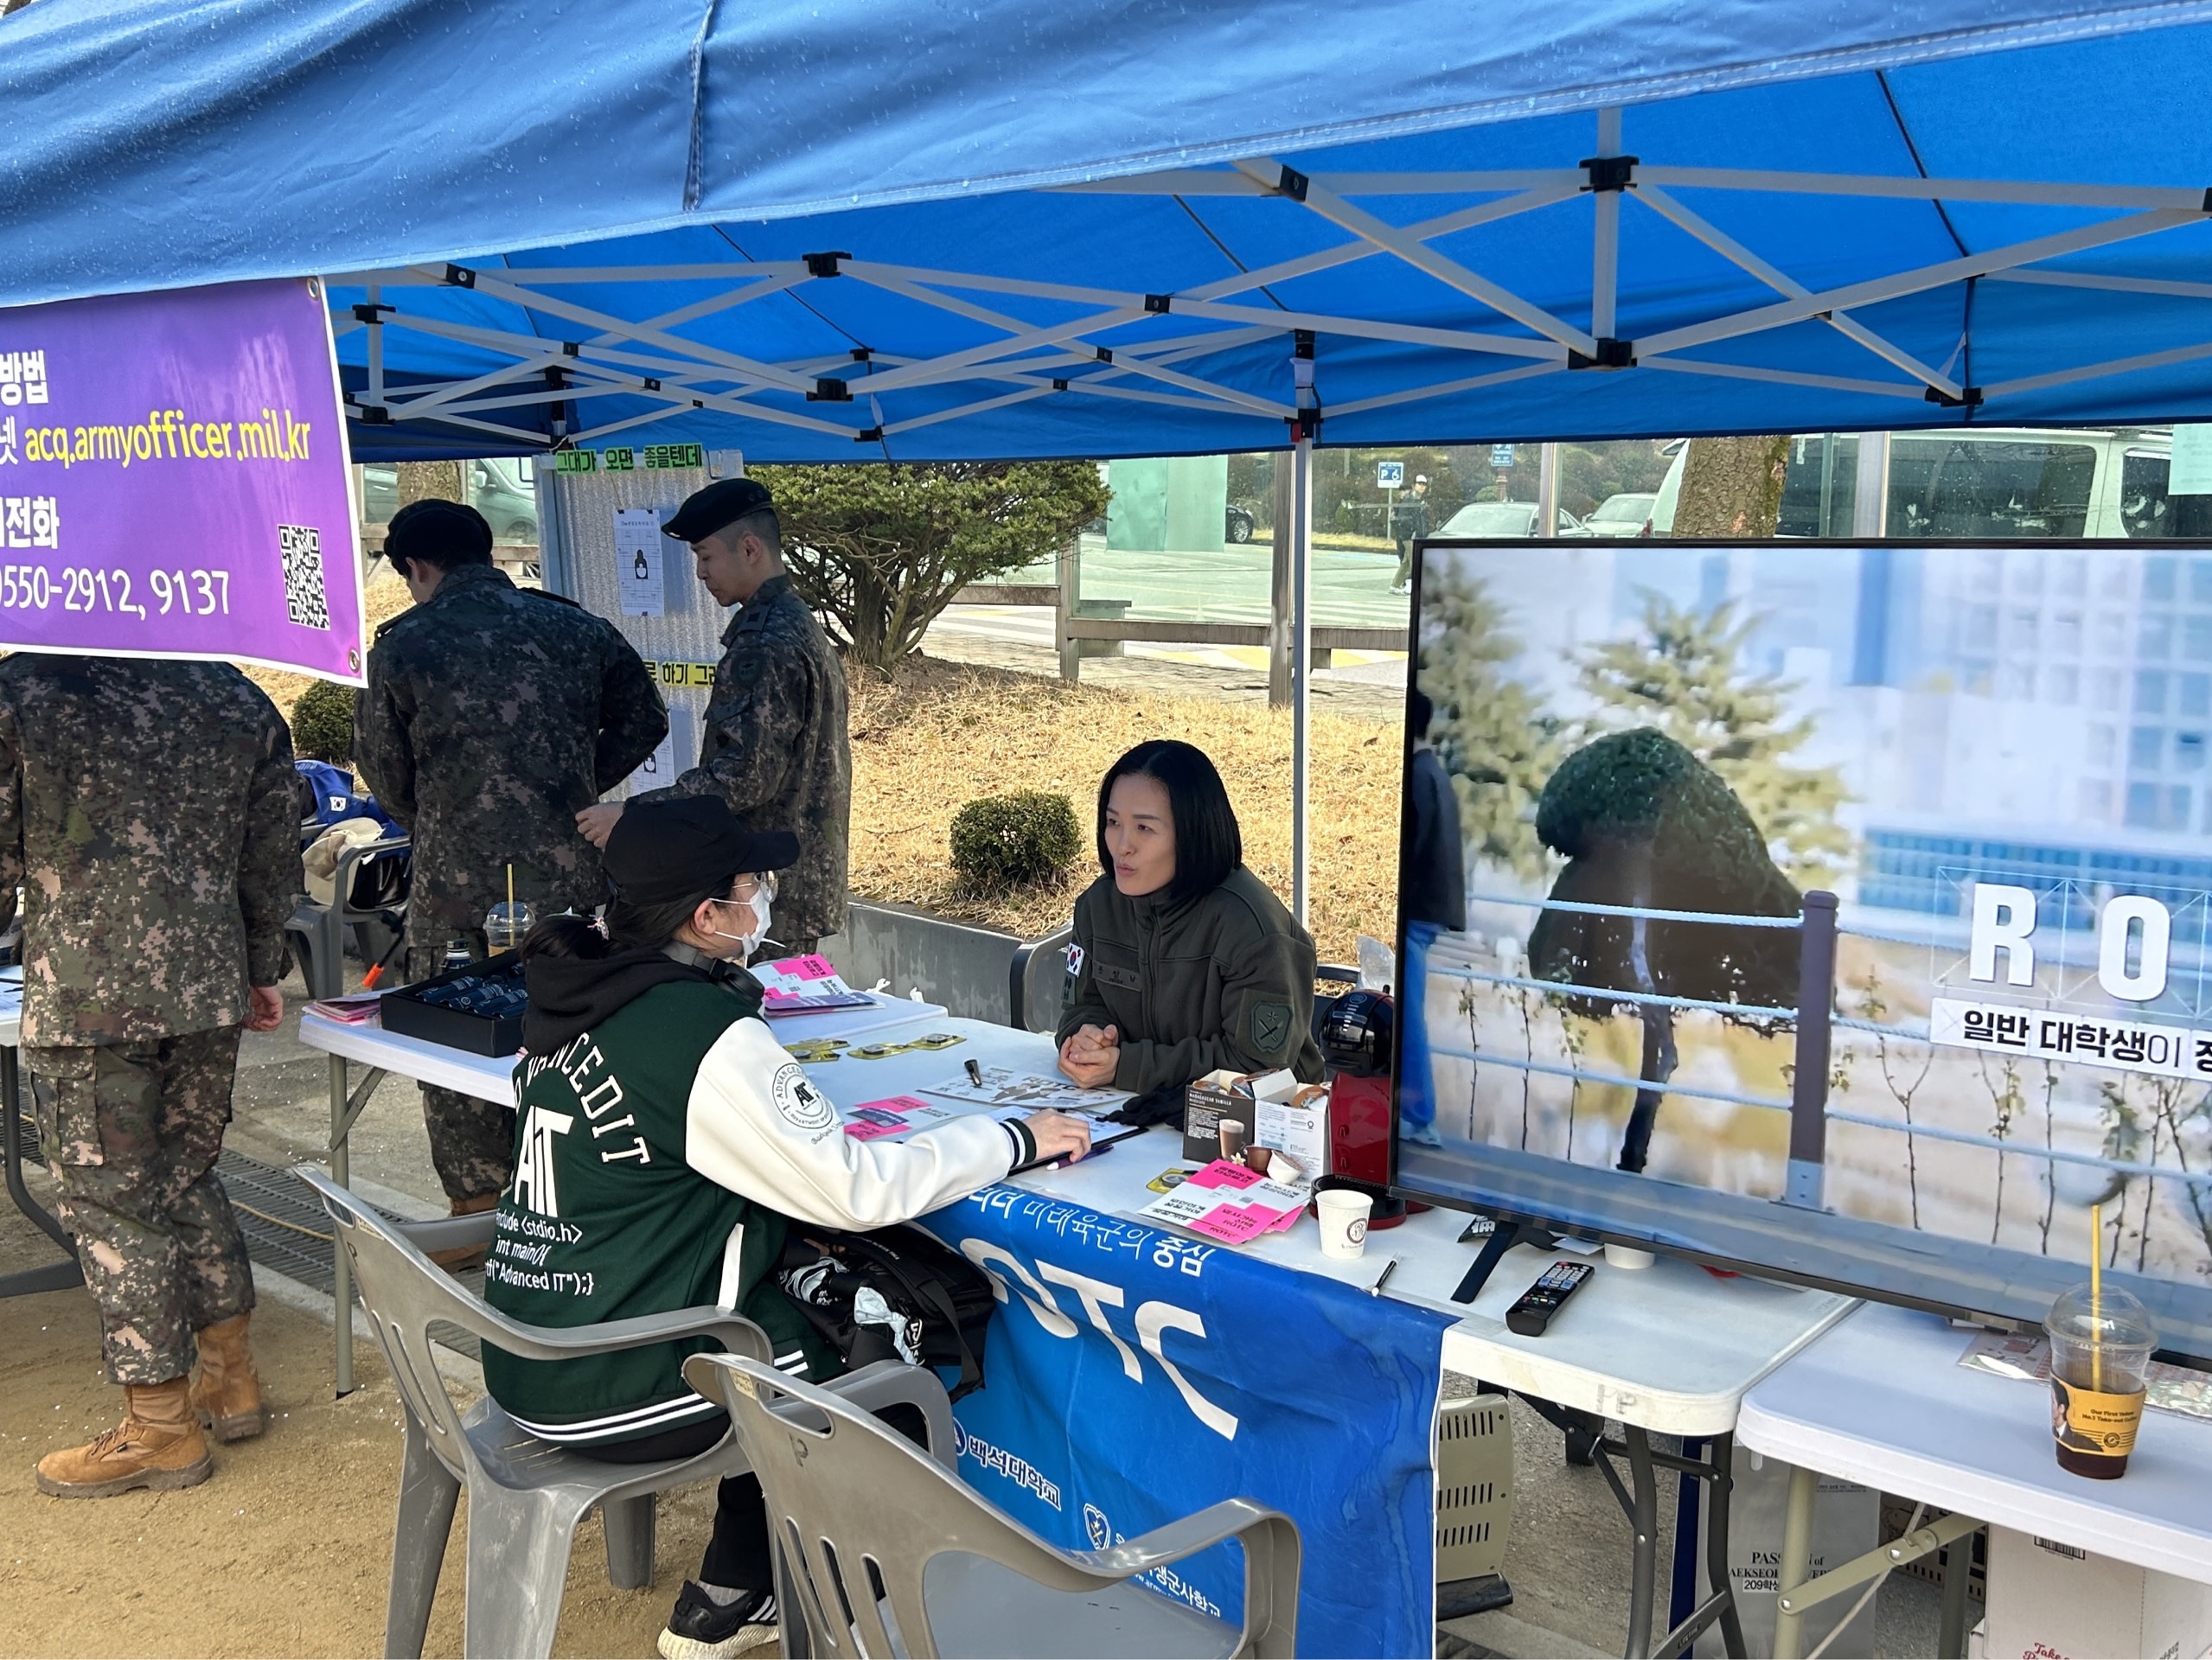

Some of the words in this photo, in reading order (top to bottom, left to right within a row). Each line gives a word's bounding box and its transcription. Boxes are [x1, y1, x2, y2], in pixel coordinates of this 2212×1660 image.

[0, 350, 49, 405] 방법
[24, 407, 310, 469] acq.armyofficer.mil.kr
[557, 451, 597, 472] 그대가
[605, 448, 635, 470] 오면
[644, 444, 703, 468] 좋을텐데
[0, 495, 61, 550] 전화
[0, 565, 147, 621] 550-2912,
[150, 570, 229, 615] 9137
[662, 663, 688, 685] 하기
[1964, 1010, 2030, 1047] 일반
[2040, 1020, 2180, 1068] 대학생이
[495, 1235, 511, 1256] int
[521, 1215, 583, 1244] <stdio.h>
[1153, 1236, 1216, 1277] 중심
[969, 1435, 1061, 1511] 백석대학교
[1814, 1556, 1825, 1566] of
